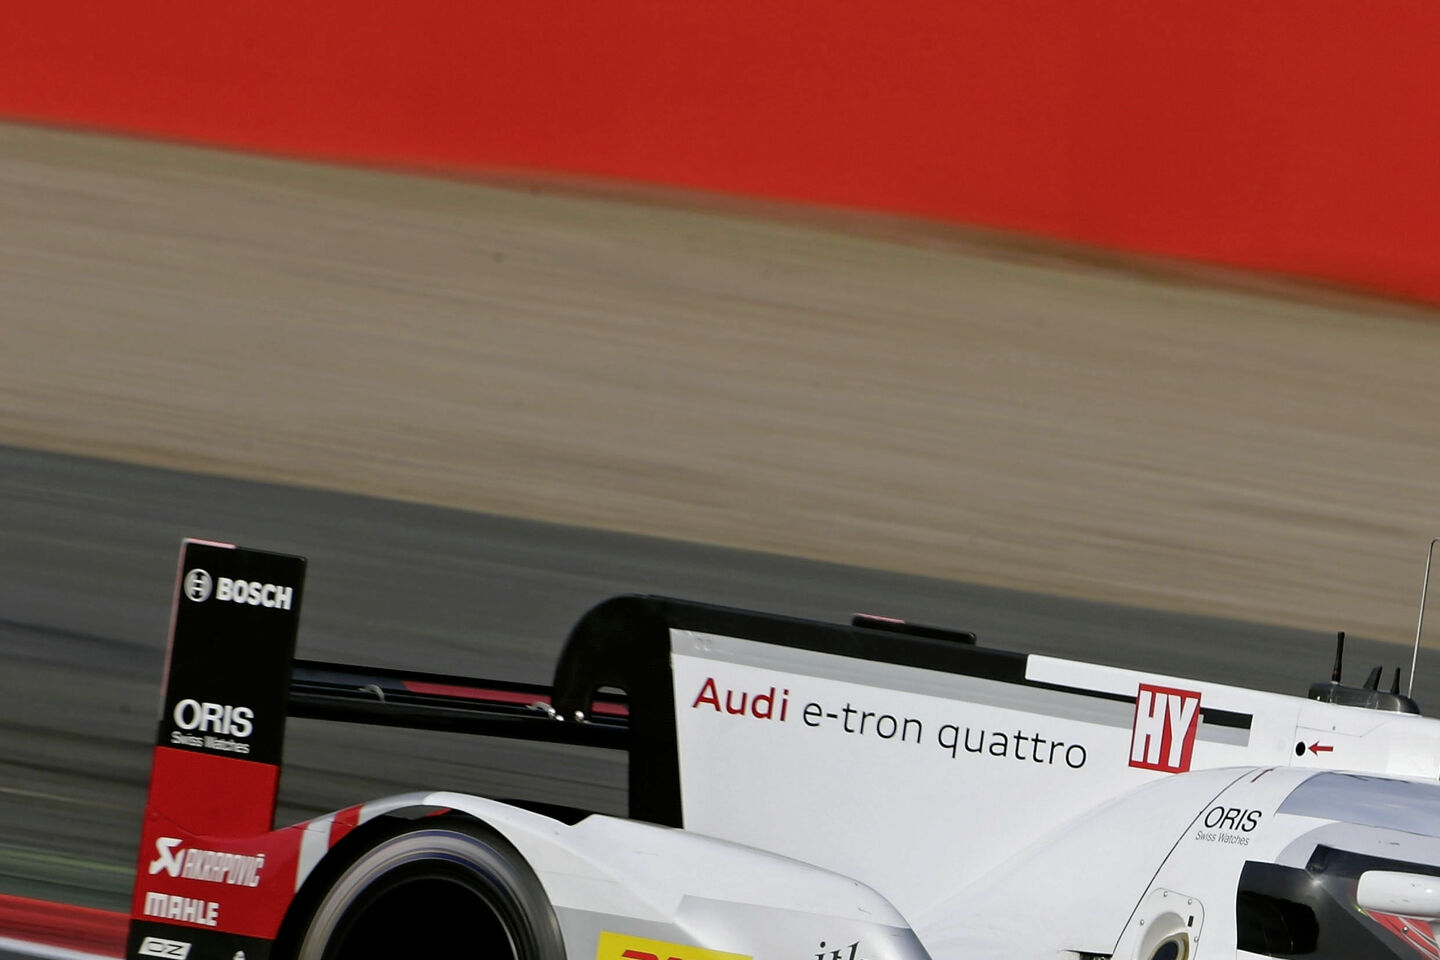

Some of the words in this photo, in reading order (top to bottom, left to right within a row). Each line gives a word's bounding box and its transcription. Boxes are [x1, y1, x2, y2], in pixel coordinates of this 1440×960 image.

[215, 577, 293, 610] BOSCH
[173, 698, 254, 737] ORIS
[691, 677, 790, 722] Audi
[802, 700, 922, 744] e-tron
[937, 722, 1088, 769] quattro
[1131, 690, 1200, 769] HY
[170, 730, 204, 748] Swiss
[203, 735, 251, 754] Watches
[1204, 805, 1263, 833] ORIS
[1195, 830, 1217, 842] Swiss
[1217, 832, 1251, 846] Watches
[143, 891, 220, 927] MAHLE
